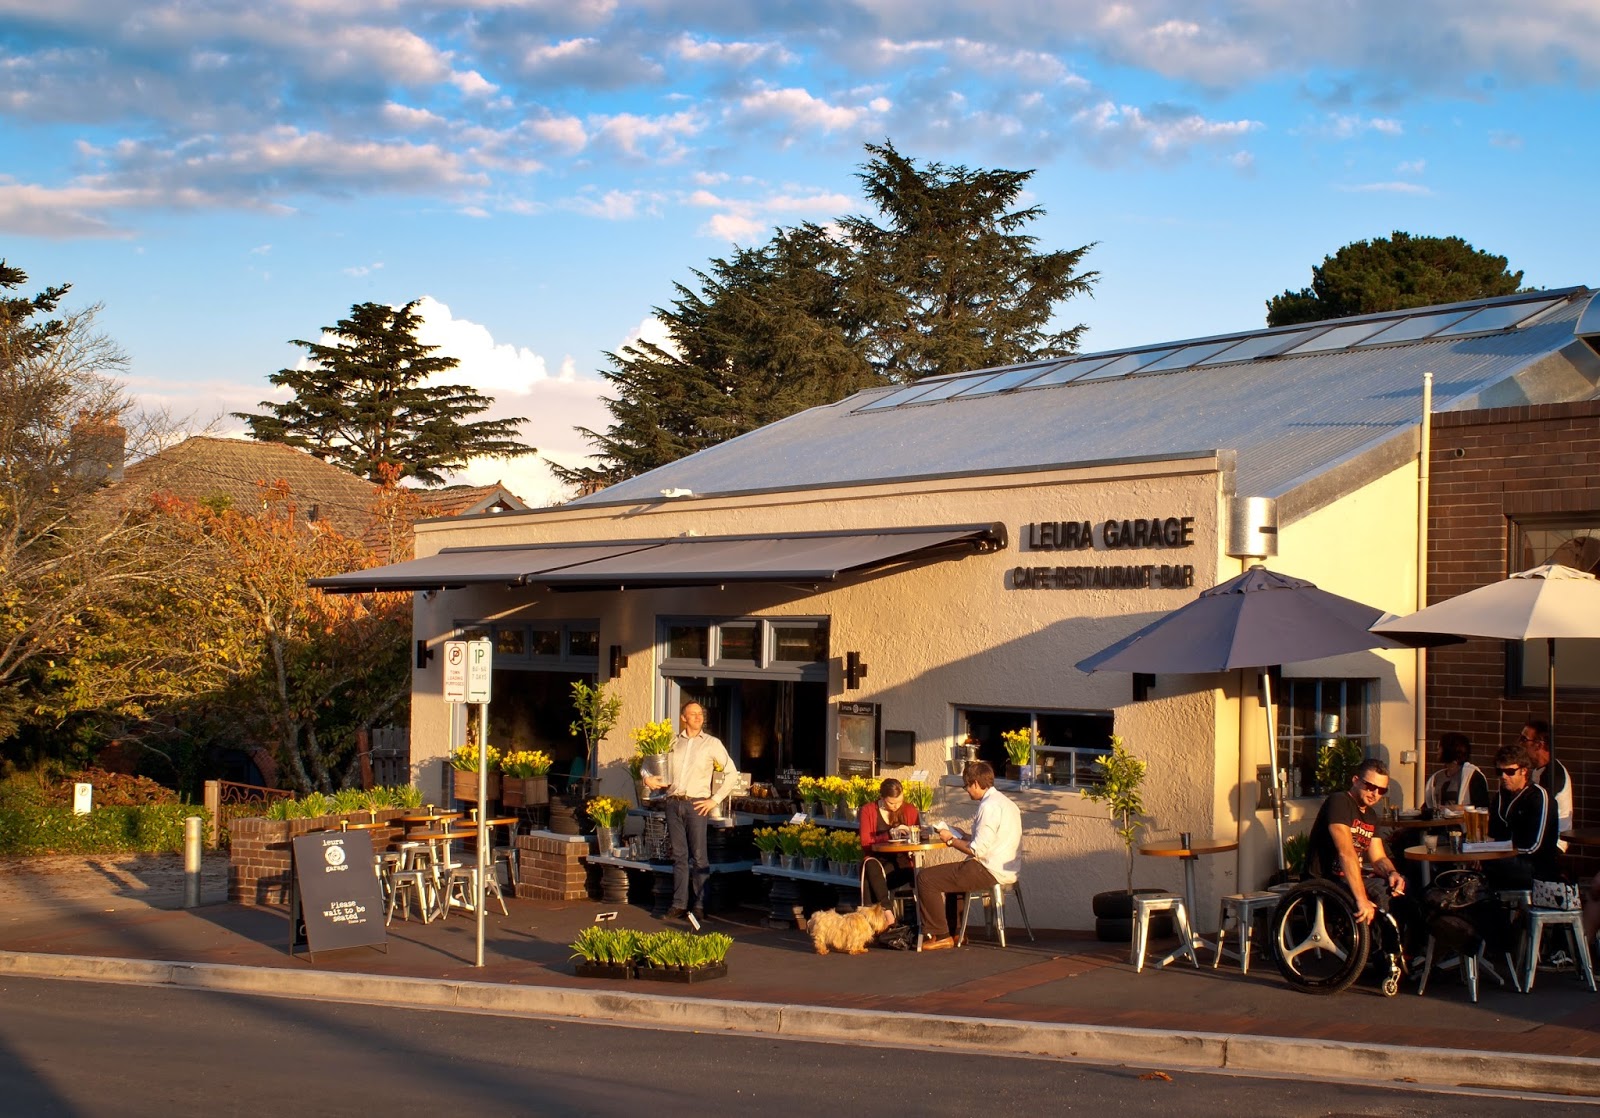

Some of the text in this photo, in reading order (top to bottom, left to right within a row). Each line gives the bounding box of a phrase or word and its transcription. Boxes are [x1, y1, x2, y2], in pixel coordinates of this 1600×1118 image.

[1029, 516, 1195, 549] LEURA GARAGE
[475, 649, 485, 664] 1P
[325, 864, 349, 872] garage
[330, 900, 356, 909] Please
[323, 908, 342, 917] wait
[355, 905, 366, 913] be
[333, 912, 359, 922] seated
